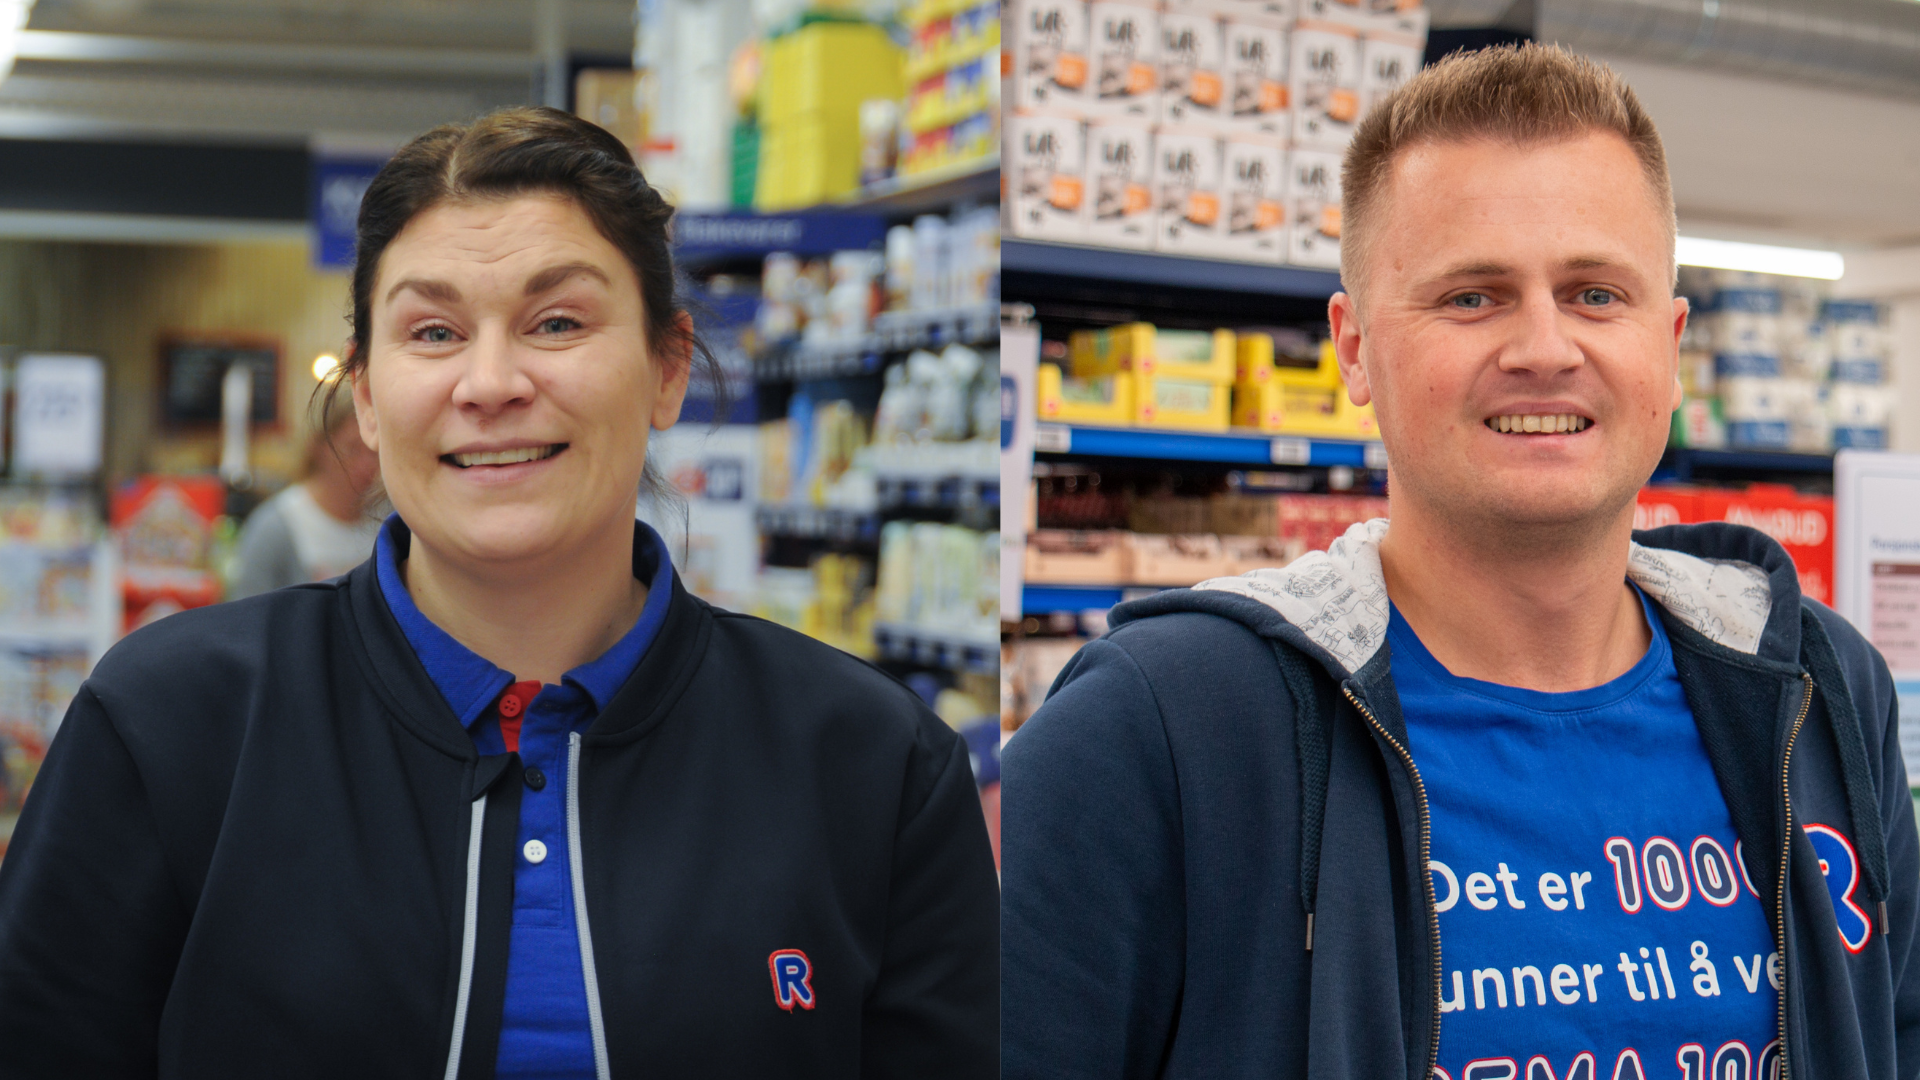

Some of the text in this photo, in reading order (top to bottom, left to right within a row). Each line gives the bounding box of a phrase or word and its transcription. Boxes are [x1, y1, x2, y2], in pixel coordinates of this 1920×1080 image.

[1429, 861, 1525, 913] Det
[1538, 870, 1592, 910] er
[768, 948, 816, 1011] R
[1617, 945, 1677, 1002] til
[1690, 940, 1721, 998] å
